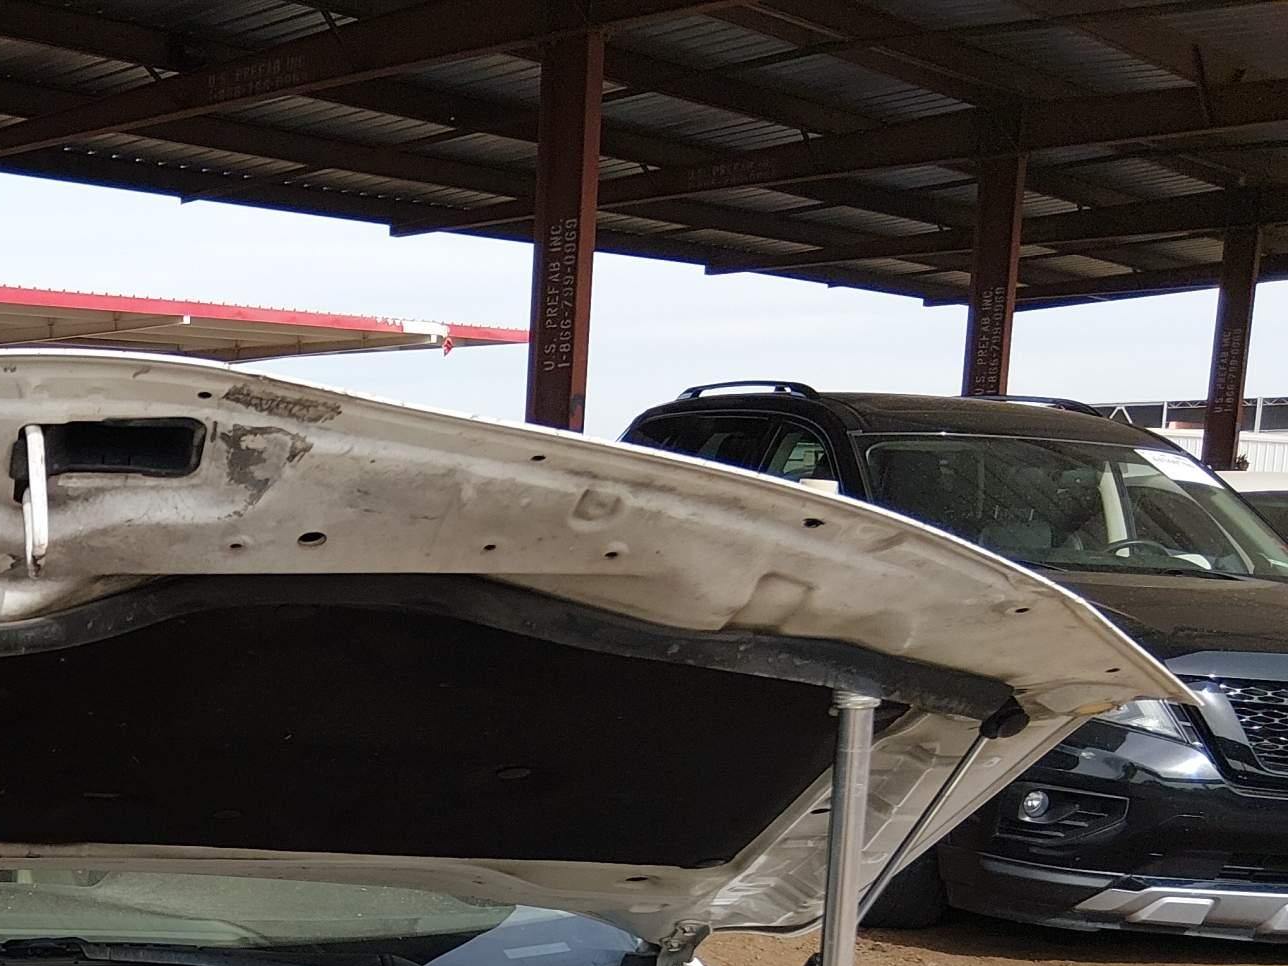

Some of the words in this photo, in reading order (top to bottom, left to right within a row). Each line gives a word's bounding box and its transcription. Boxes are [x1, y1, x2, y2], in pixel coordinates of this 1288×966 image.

[549, 218, 562, 253] INC.
[545, 261, 561, 329] PREFAB
[543, 337, 558, 371] U.S.
